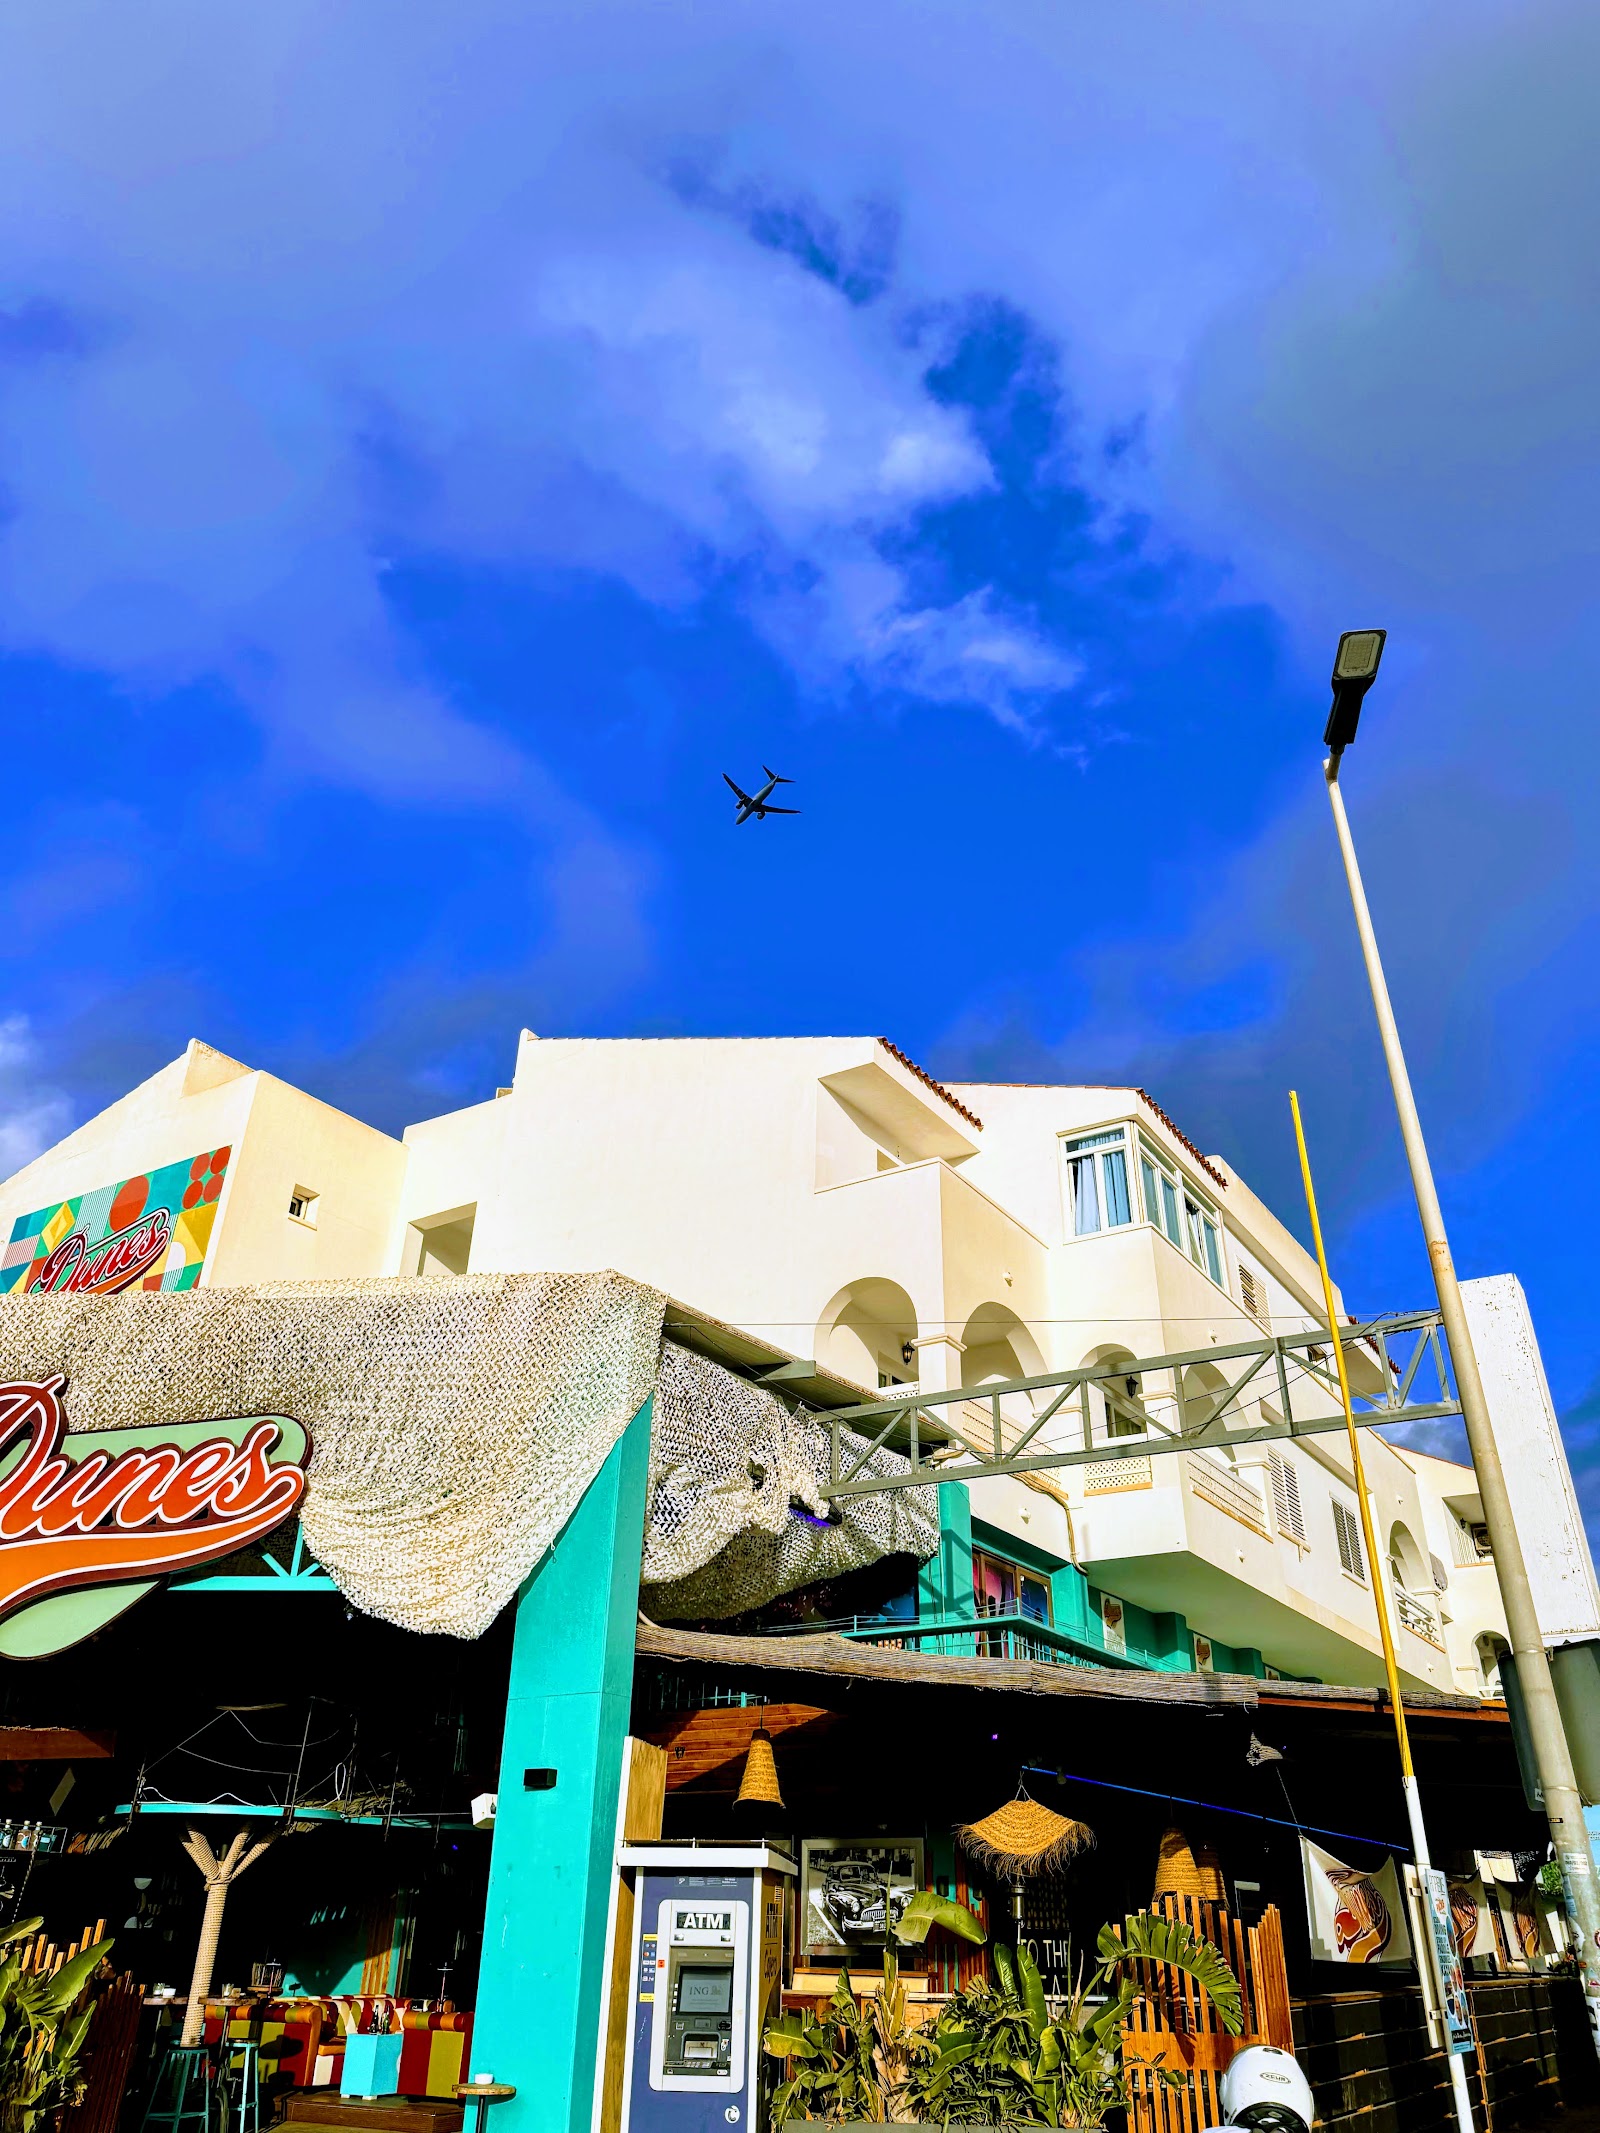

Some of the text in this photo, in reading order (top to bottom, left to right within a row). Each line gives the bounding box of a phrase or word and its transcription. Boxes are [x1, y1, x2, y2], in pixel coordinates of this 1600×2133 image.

[40, 1218, 169, 1294] Dunes
[683, 1913, 724, 1929] ATM
[689, 1986, 709, 1995] ING
